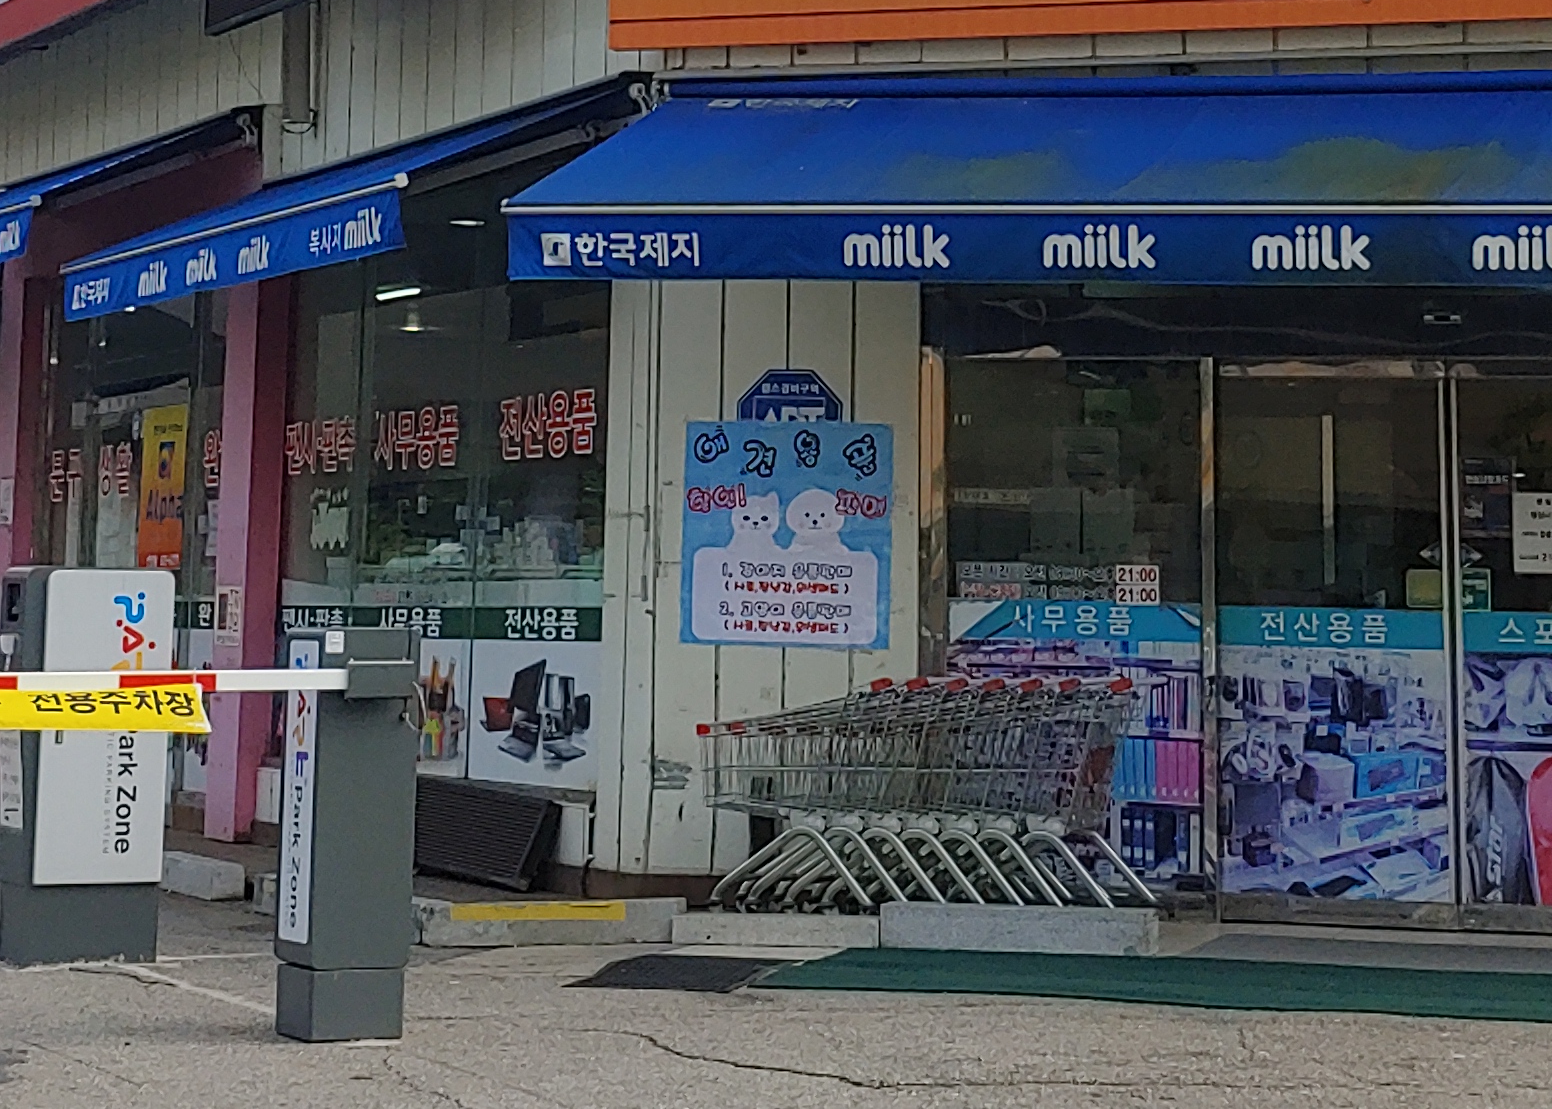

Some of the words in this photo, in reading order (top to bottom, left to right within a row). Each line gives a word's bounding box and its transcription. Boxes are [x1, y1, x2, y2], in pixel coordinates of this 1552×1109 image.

[575, 231, 699, 268] 한국제지
[843, 224, 951, 269] miilk
[1043, 224, 1157, 269] miilk
[1251, 224, 1370, 271] miilk
[375, 406, 459, 470] 사무용품
[500, 389, 596, 460] 전산용품
[1118, 568, 1157, 582] 21:00
[1118, 588, 1157, 602] 21:00
[504, 608, 578, 640] 전산용품
[1013, 606, 1134, 636] 사무용품
[1260, 611, 1389, 644] 전산용품
[30, 690, 195, 717] 전용주차장
[117, 729, 138, 776] ark
[114, 785, 137, 854] Zone
[292, 785, 303, 848] Park
[289, 857, 301, 928] Zone
